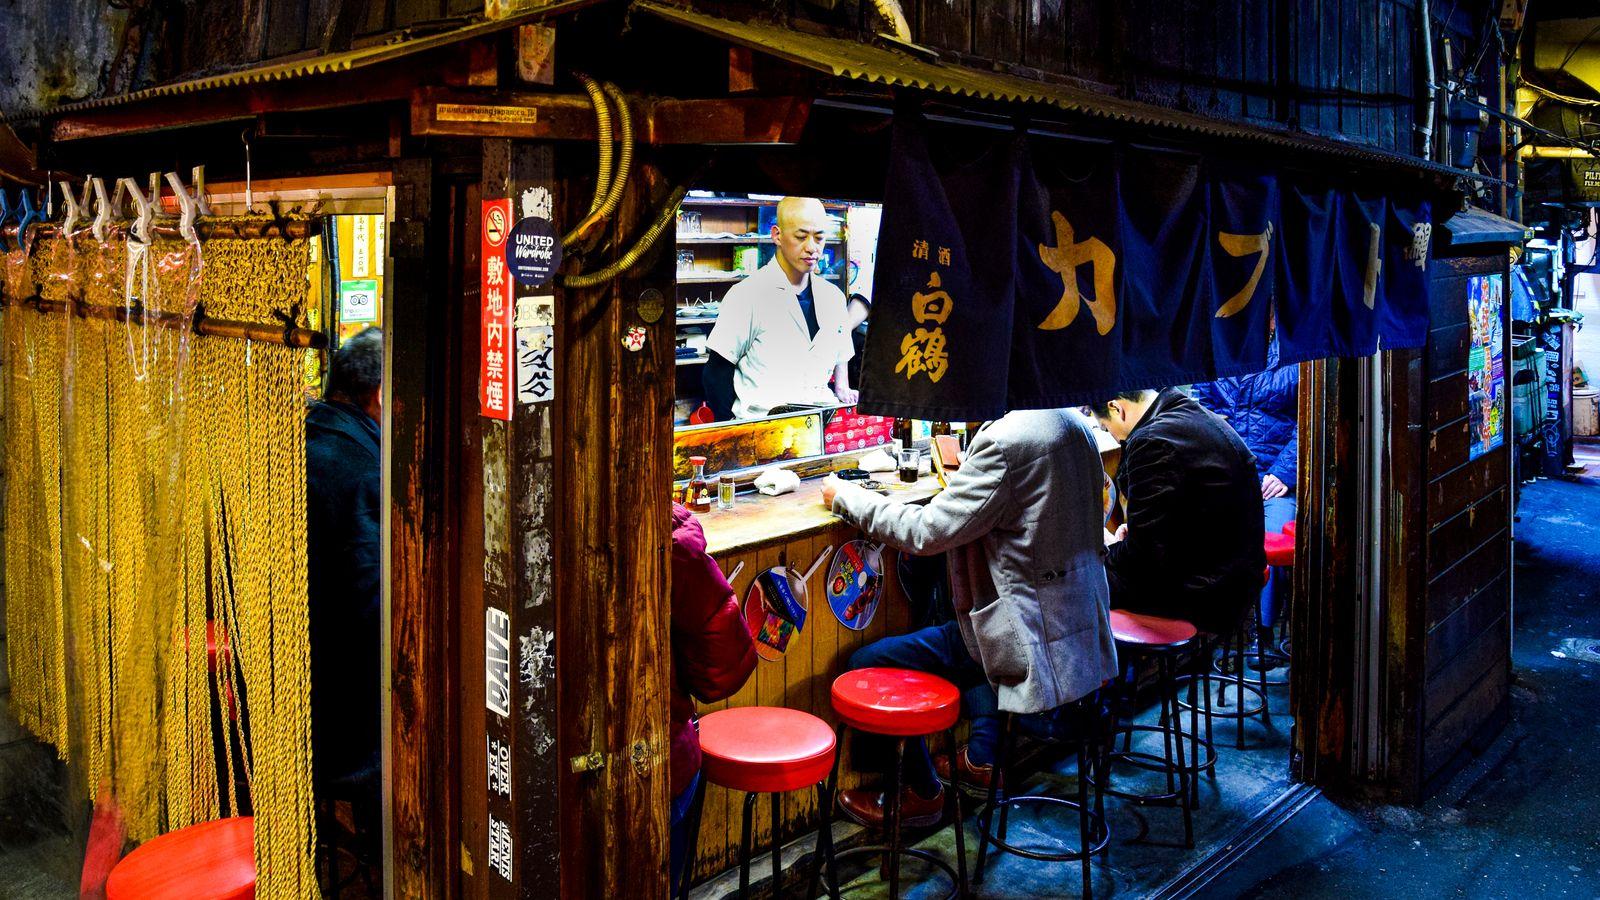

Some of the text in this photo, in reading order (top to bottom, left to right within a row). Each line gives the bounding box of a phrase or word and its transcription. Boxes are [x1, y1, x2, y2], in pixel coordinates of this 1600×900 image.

[515, 234, 554, 247] UNITED
[515, 244, 553, 264] Wardrobe
[912, 239, 951, 267] 清酒
[486, 255, 504, 411] 敷地内禁煙
[895, 271, 954, 384] 白鶴
[499, 746, 510, 794] OVER
[490, 818, 500, 870] STAR!
